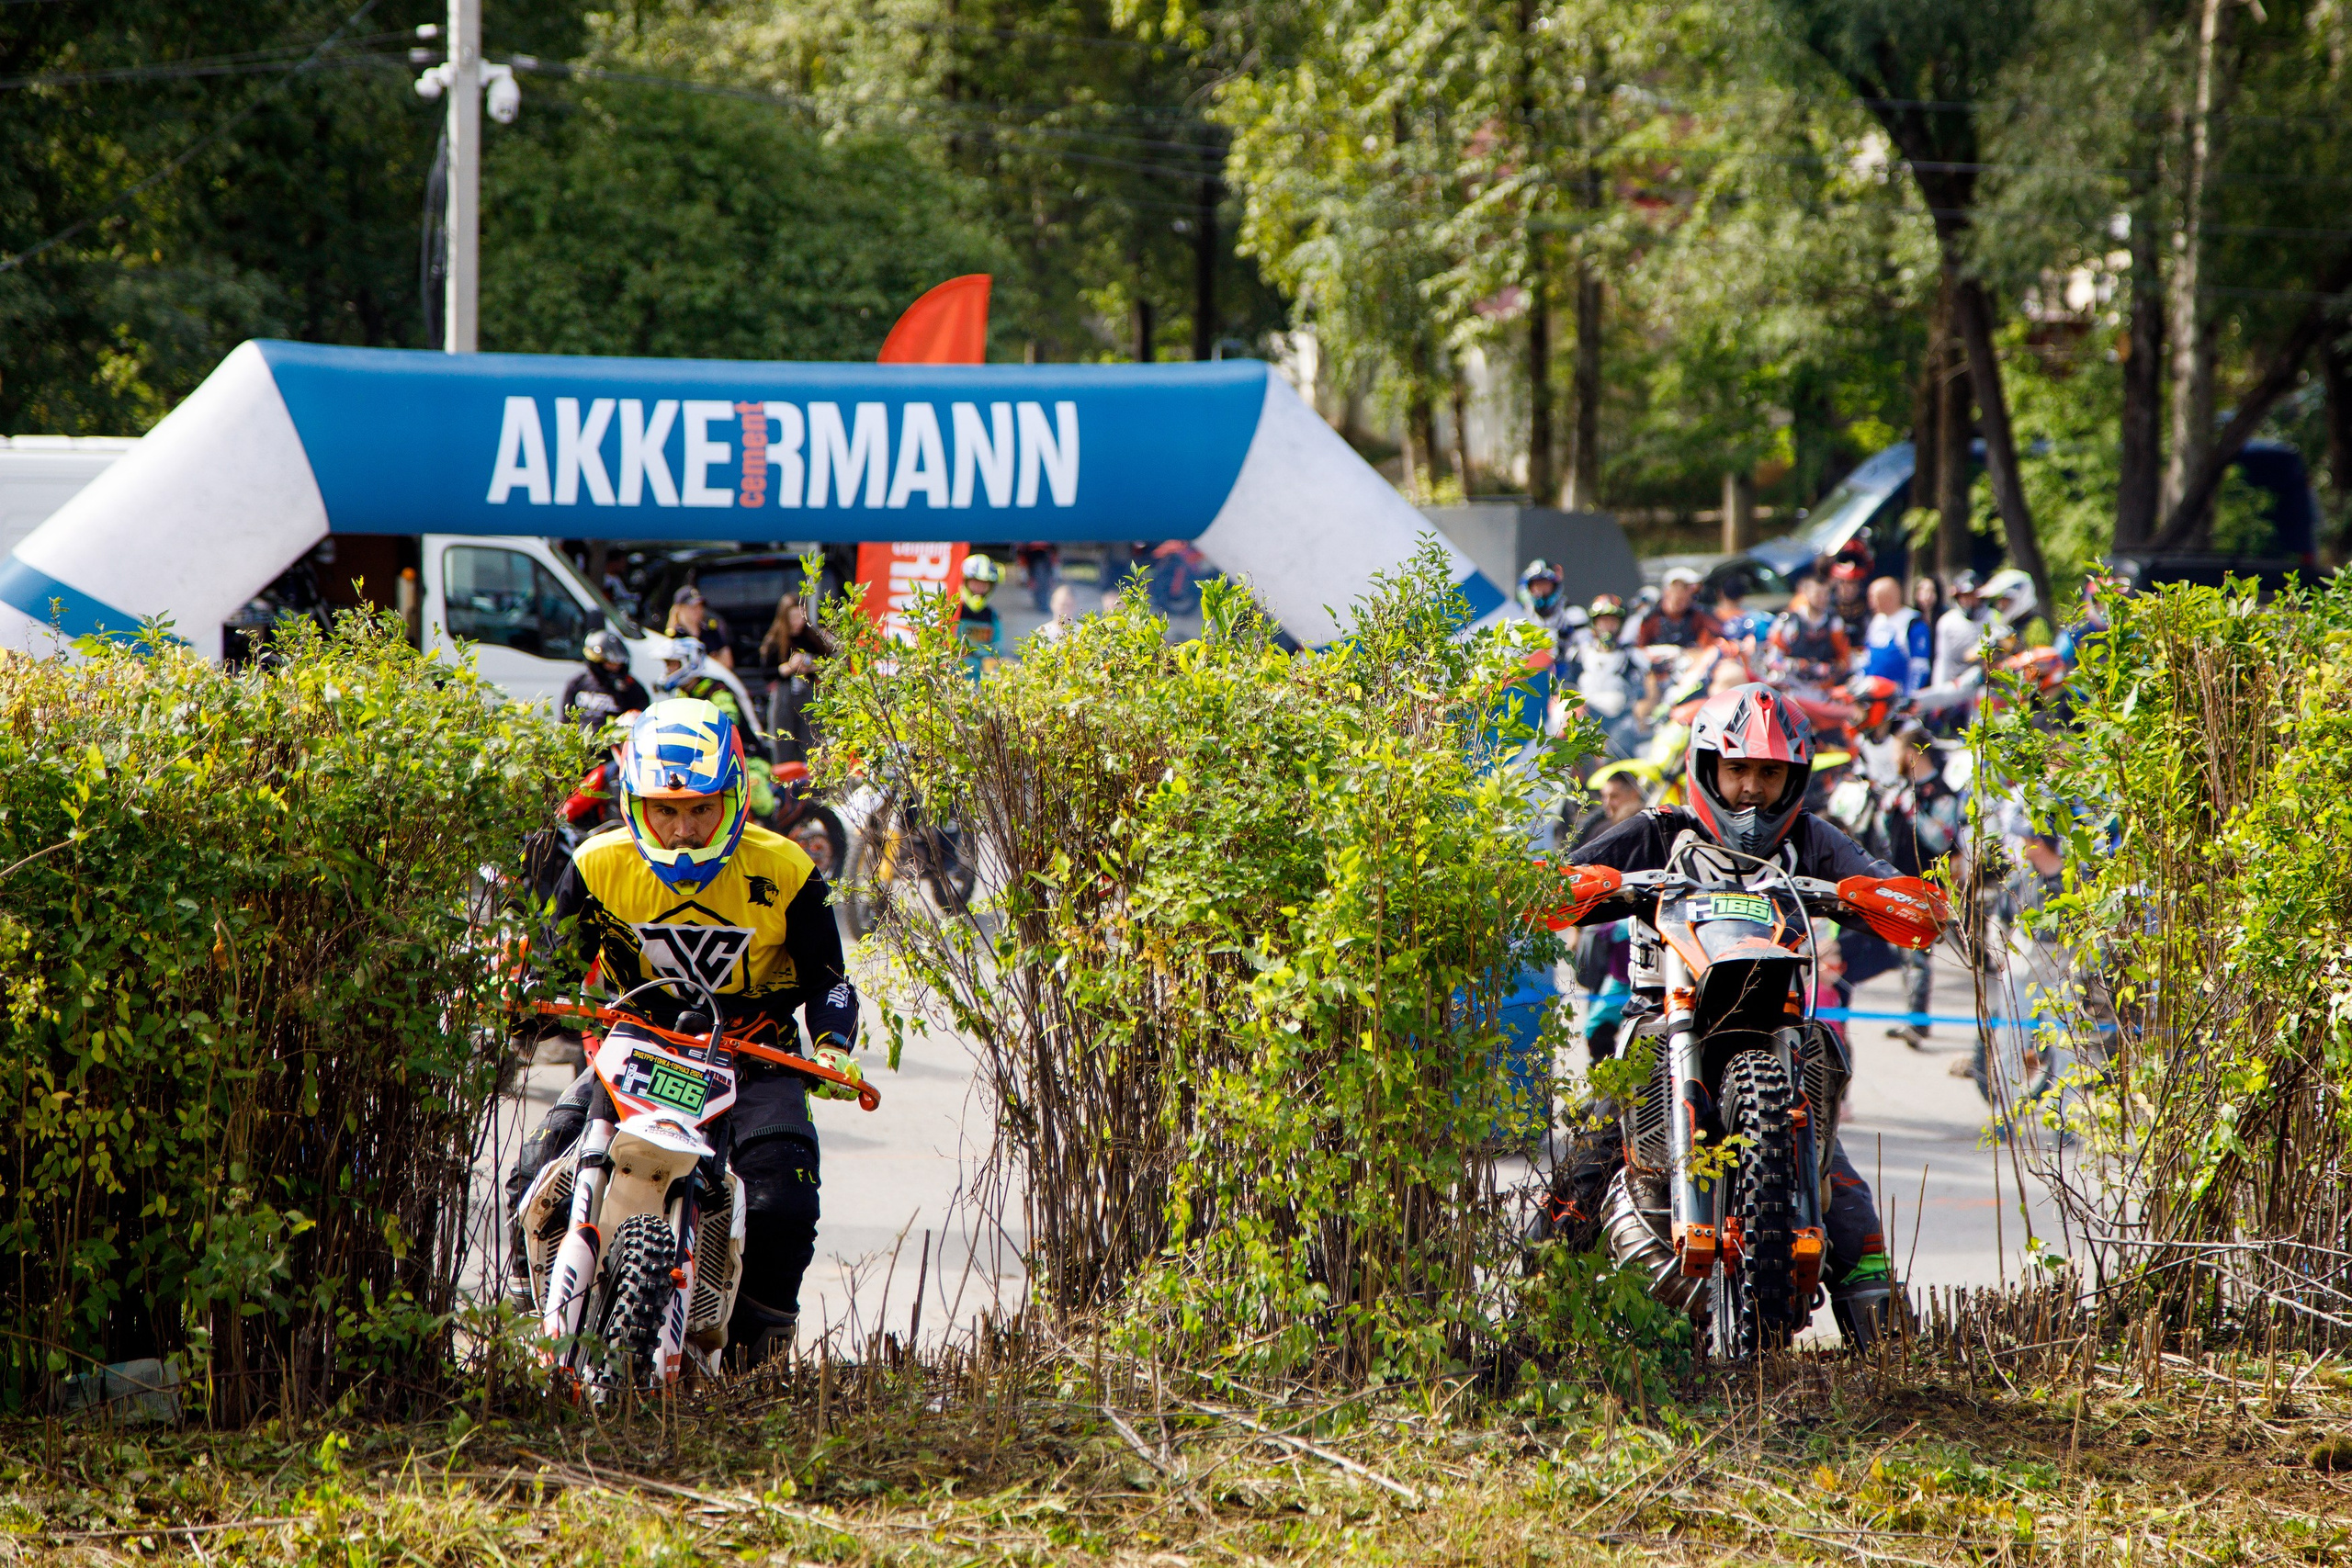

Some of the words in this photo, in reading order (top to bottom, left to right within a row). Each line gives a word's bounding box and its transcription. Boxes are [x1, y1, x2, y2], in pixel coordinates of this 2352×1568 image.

[485, 396, 1080, 509] AKKERMANN
[734, 400, 768, 508] cement
[1716, 899, 1770, 919] 165
[651, 1071, 706, 1109] 166
